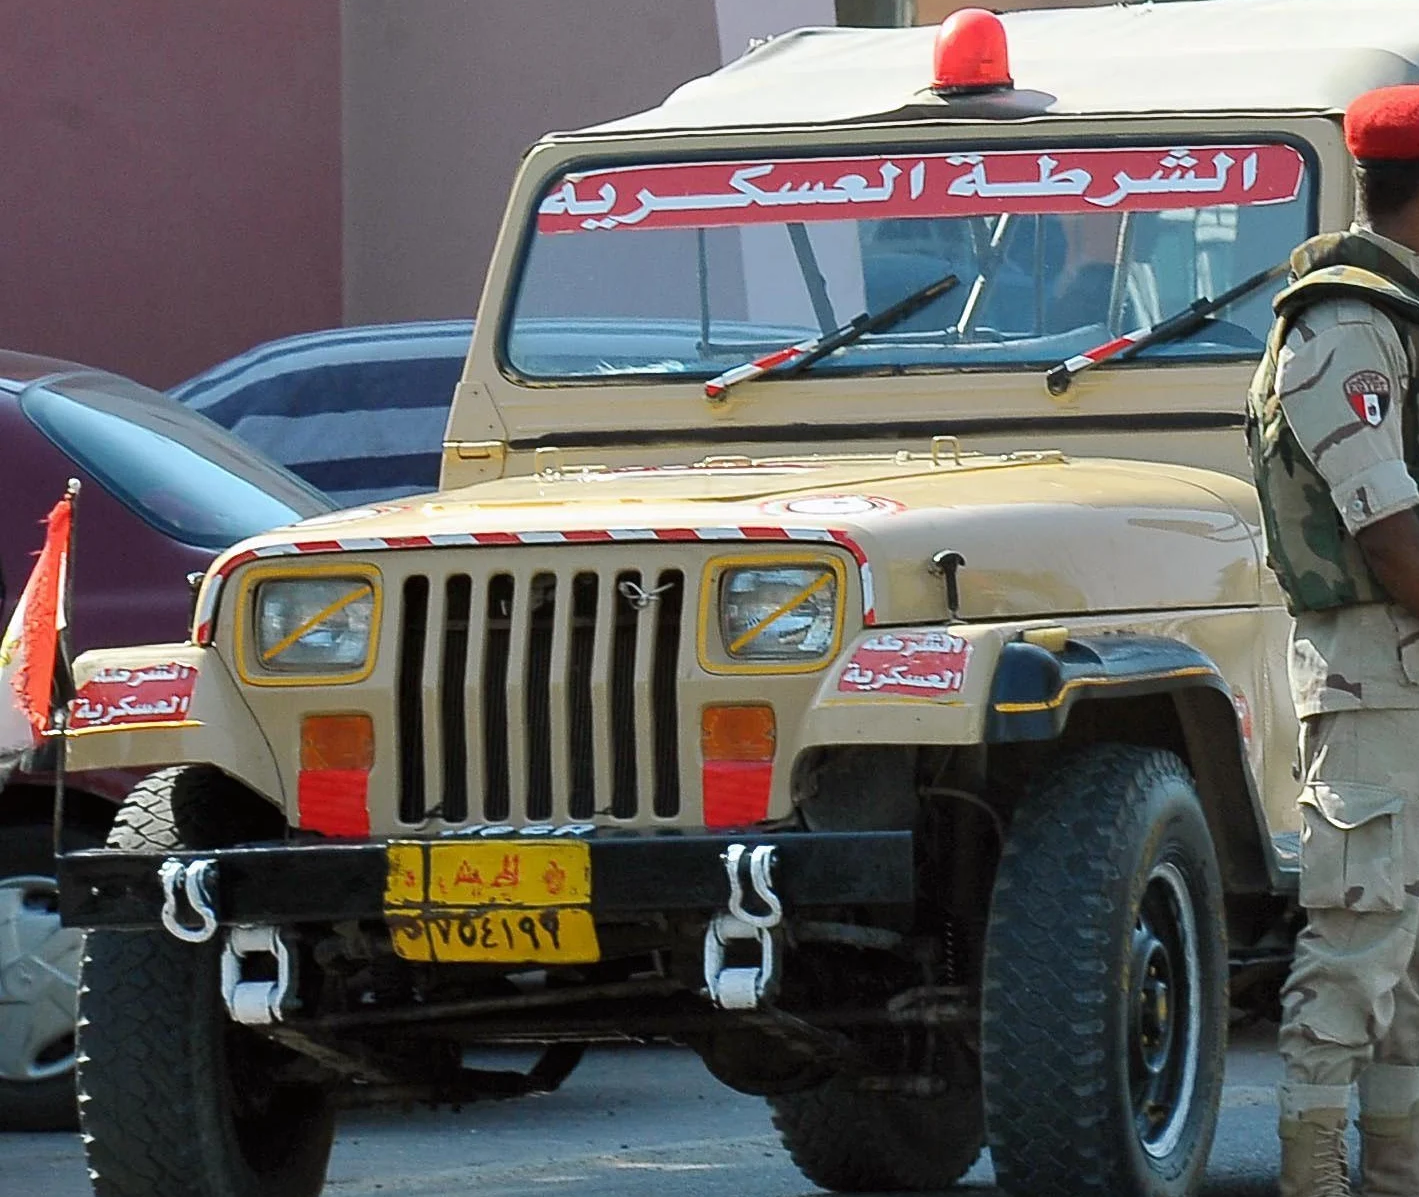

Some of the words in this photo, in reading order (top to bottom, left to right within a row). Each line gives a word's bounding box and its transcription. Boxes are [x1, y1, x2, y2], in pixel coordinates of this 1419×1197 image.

[946, 147, 1258, 207] الشرطة
[843, 662, 963, 691] العسكرية
[74, 694, 189, 725] العسكرية
